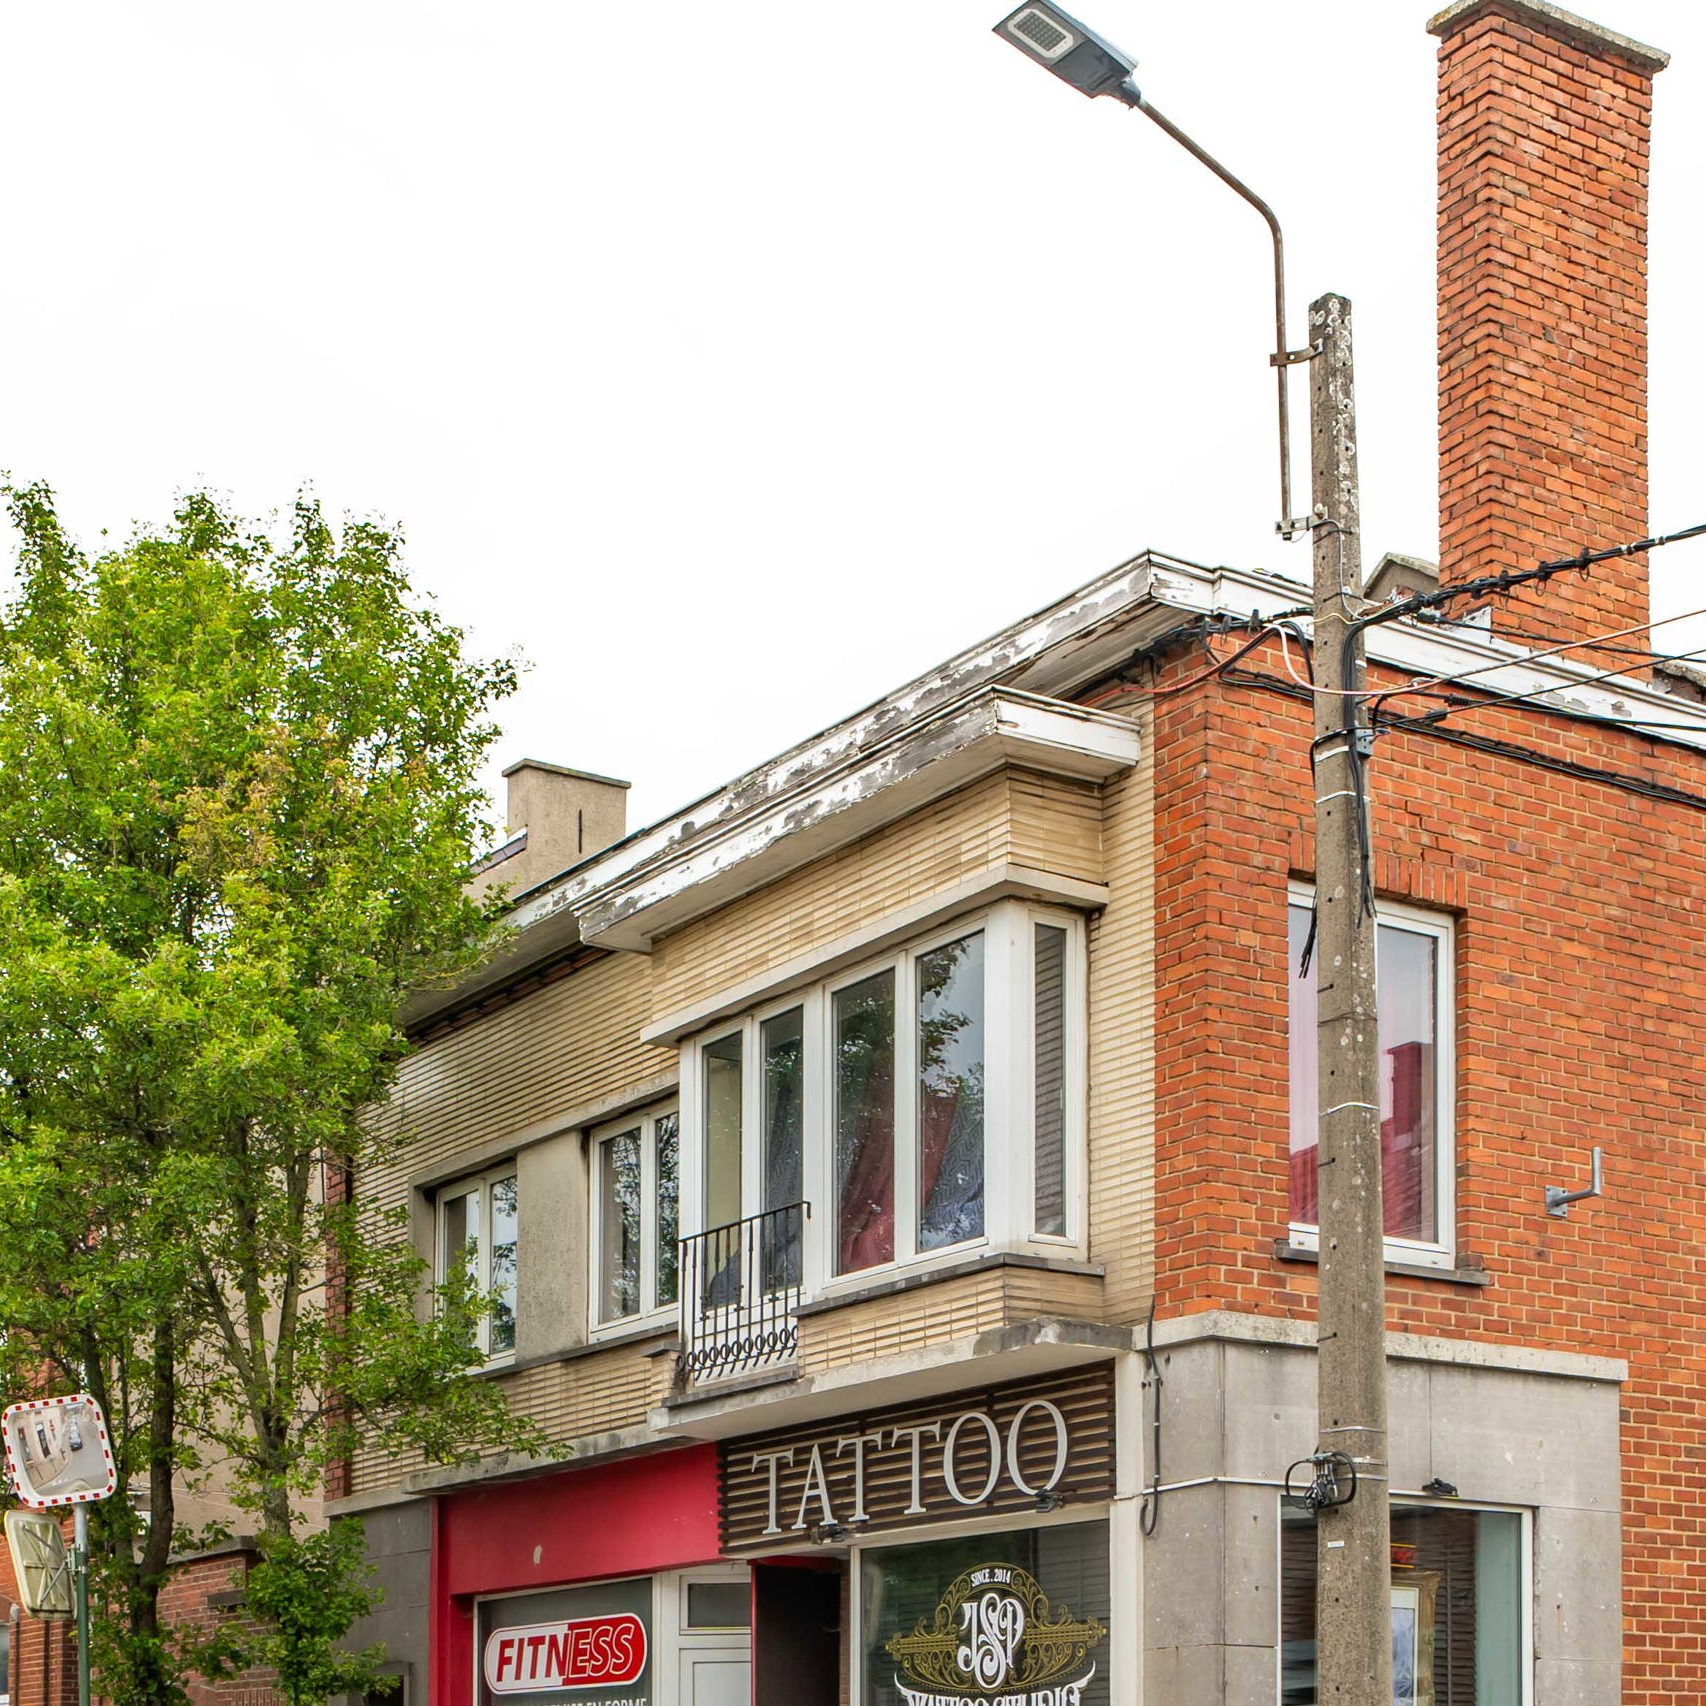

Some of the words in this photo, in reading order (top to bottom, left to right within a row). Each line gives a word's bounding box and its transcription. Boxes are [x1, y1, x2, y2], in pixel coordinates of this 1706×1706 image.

[751, 1400, 1068, 1535] TATTOO
[496, 1624, 635, 1683] FITNESS
[957, 1593, 1024, 1688] JSP
